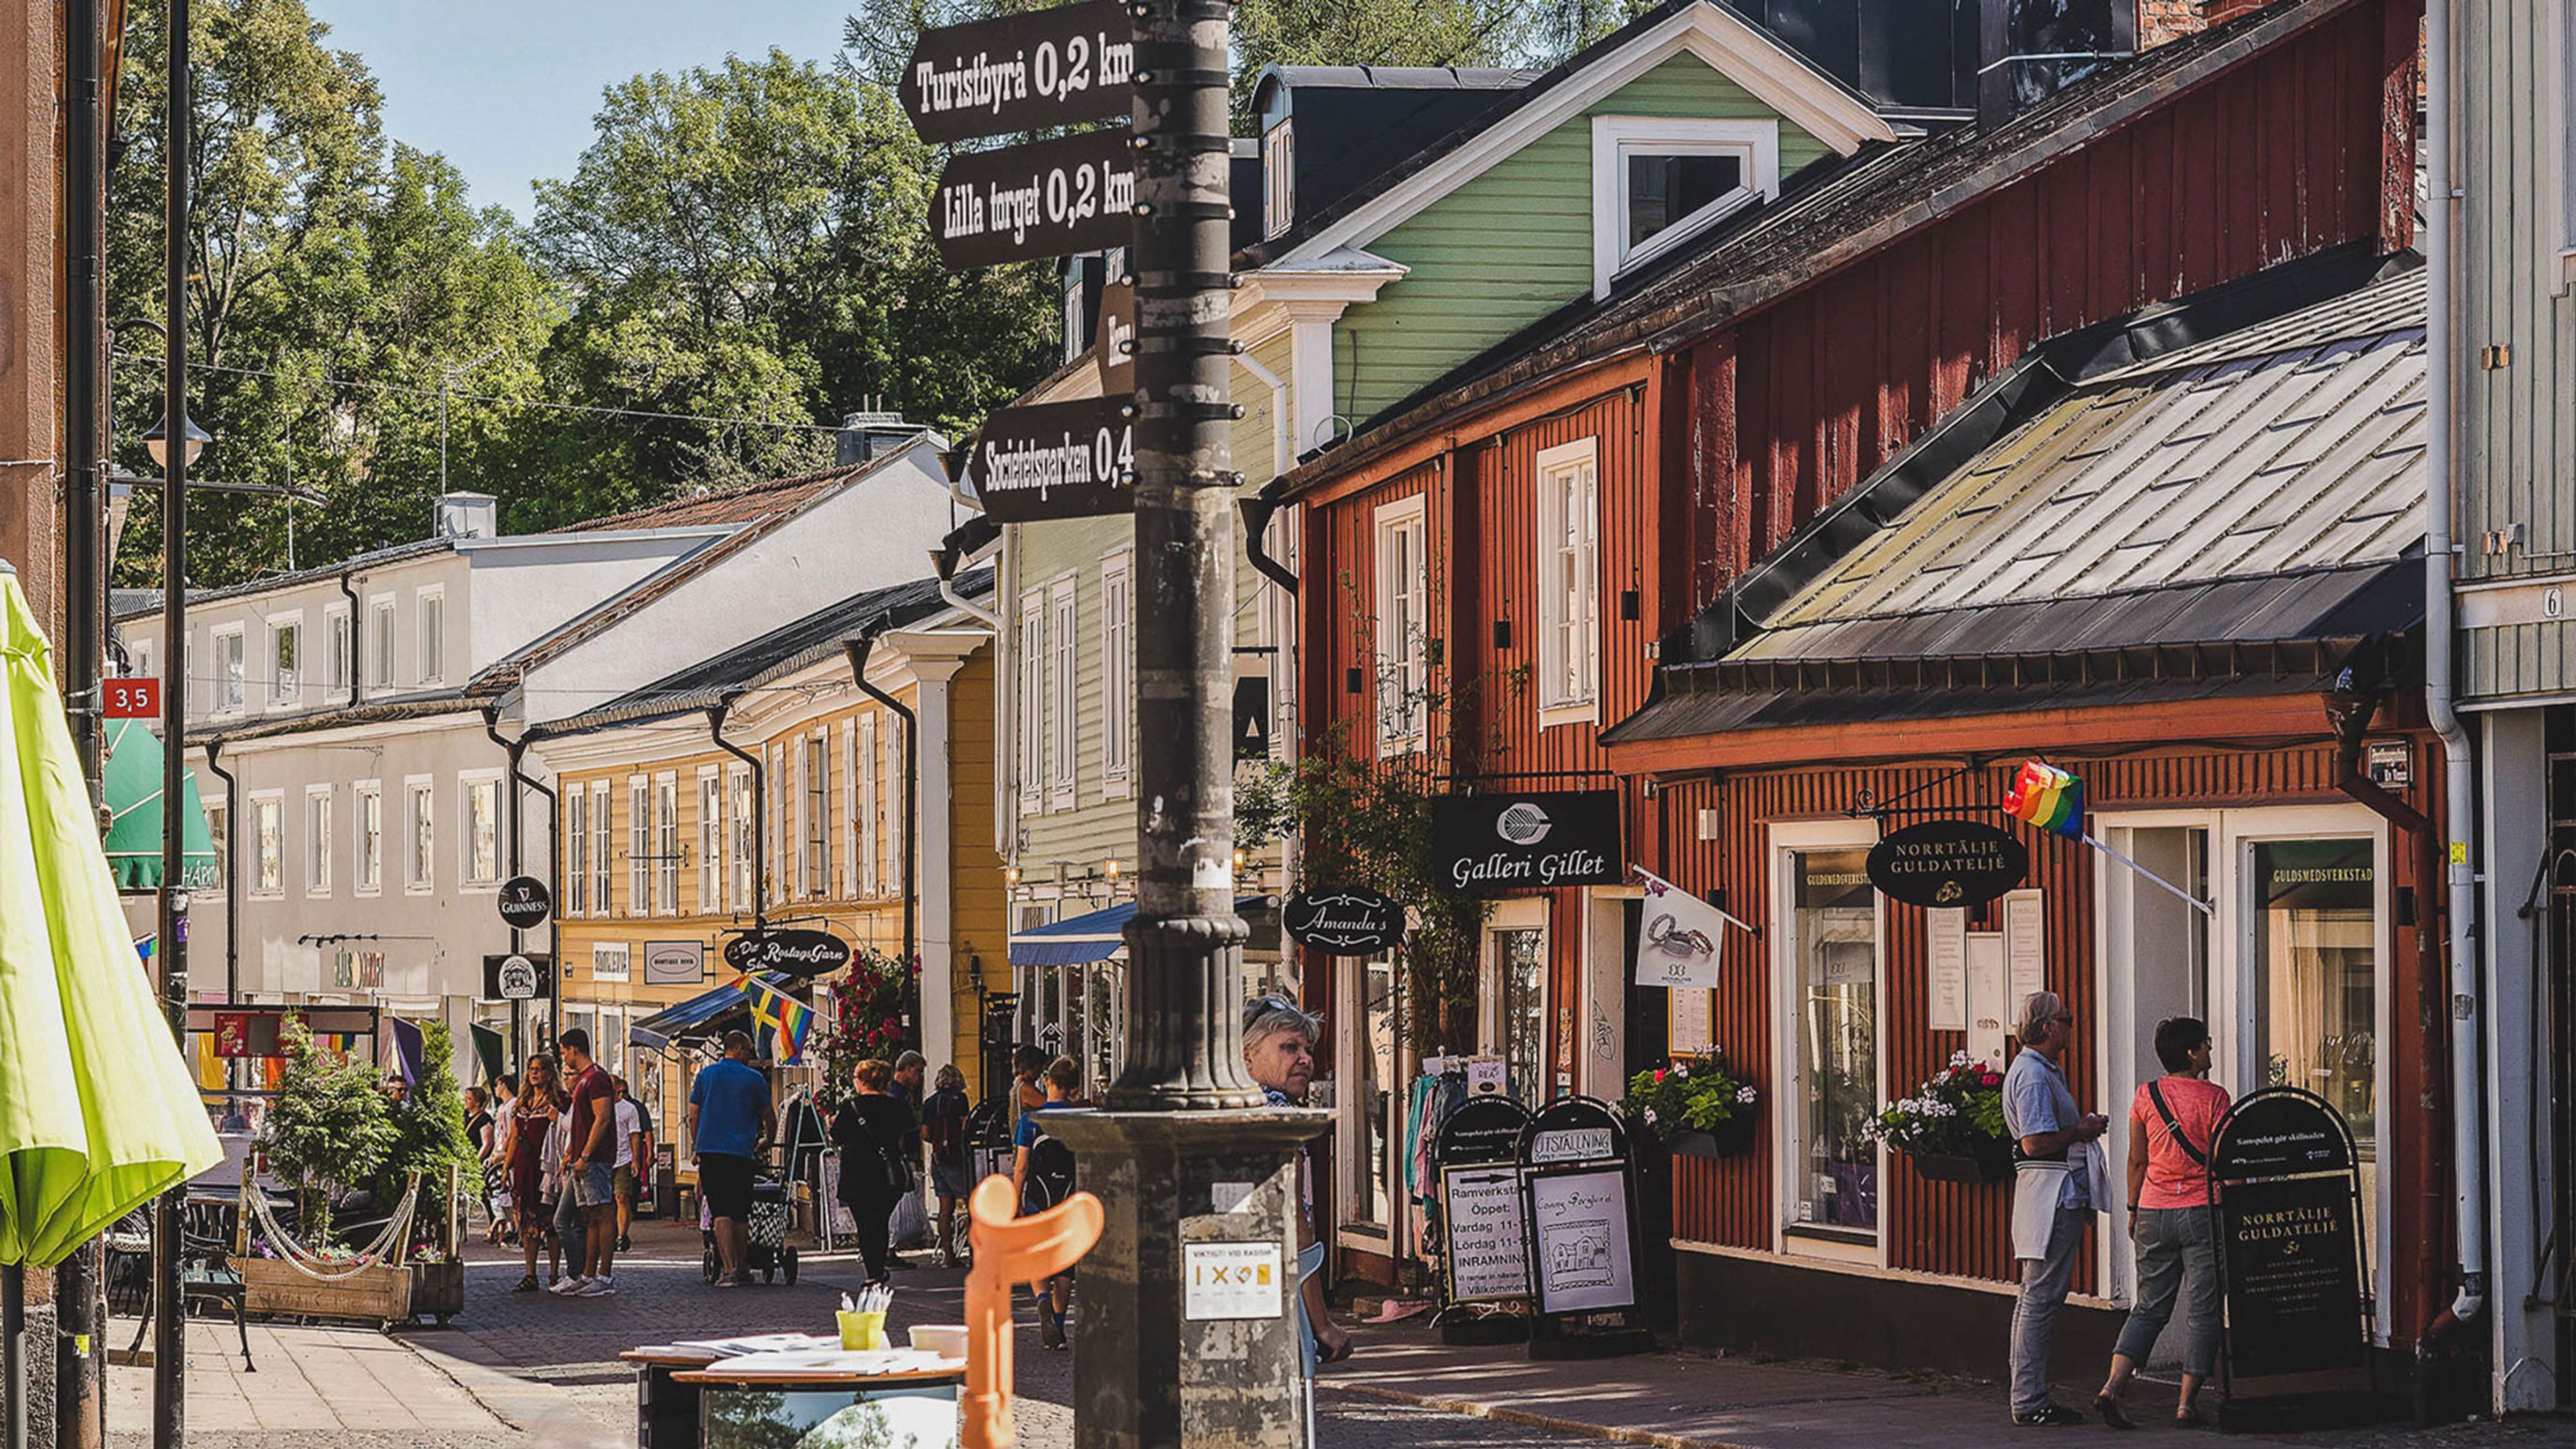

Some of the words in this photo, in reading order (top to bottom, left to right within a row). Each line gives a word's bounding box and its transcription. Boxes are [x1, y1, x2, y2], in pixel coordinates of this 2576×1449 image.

[916, 50, 1027, 114] Turistbyrå
[1034, 36, 1090, 103] 0,2
[1098, 32, 1134, 86] km
[943, 182, 984, 239] Lilla
[990, 175, 1040, 245] torget
[1046, 163, 1096, 229] 0,2
[1103, 160, 1134, 214] km
[985, 431, 1091, 501] Societetsparken
[1095, 425, 1134, 488] 0,4
[2548, 590, 2557, 614] 6
[115, 688, 148, 712] 3,5
[1896, 840, 1998, 857] NORRTÄLJE
[1452, 853, 1532, 888] Galleri
[1540, 850, 1605, 885] Gillet
[2273, 868, 2373, 883] GULDSMEDSVERKSTAD
[502, 901, 547, 914] GUINNESS
[1471, 1202, 1510, 1216] Öppet:
[2243, 1206, 2331, 1226] NORRTÄLJE
[1452, 1221, 1493, 1234] Vardag
[1455, 1240, 1496, 1250] Lördag
